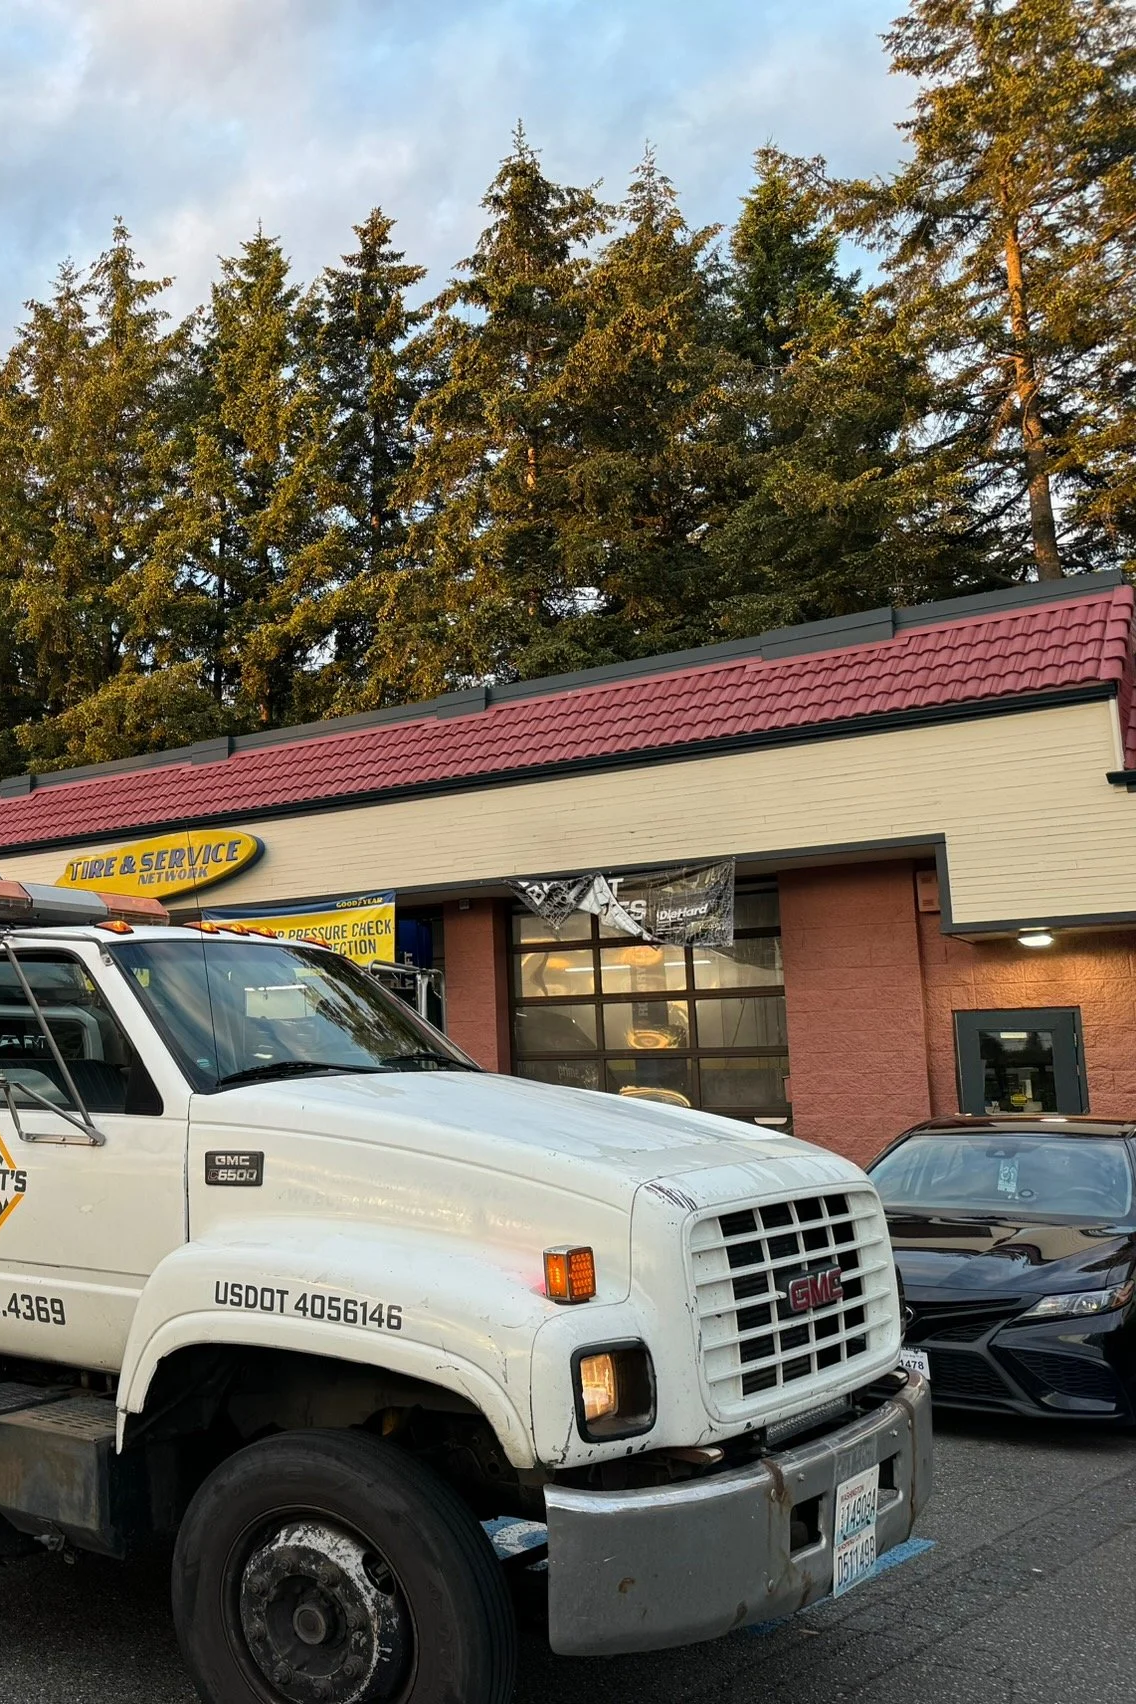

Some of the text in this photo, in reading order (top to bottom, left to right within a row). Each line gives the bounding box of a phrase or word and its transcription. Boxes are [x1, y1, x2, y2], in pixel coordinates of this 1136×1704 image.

[70, 839, 241, 881] TIRE & SERVICE
[138, 865, 209, 885] NETWORK
[336, 896, 383, 909] GOODYEAR
[288, 924, 348, 941] PRESSURE
[351, 919, 392, 937] CHECK
[215, 1155, 250, 1166] GMC
[789, 1266, 843, 1311] GMC
[215, 1280, 403, 1331] USDOT 4056146
